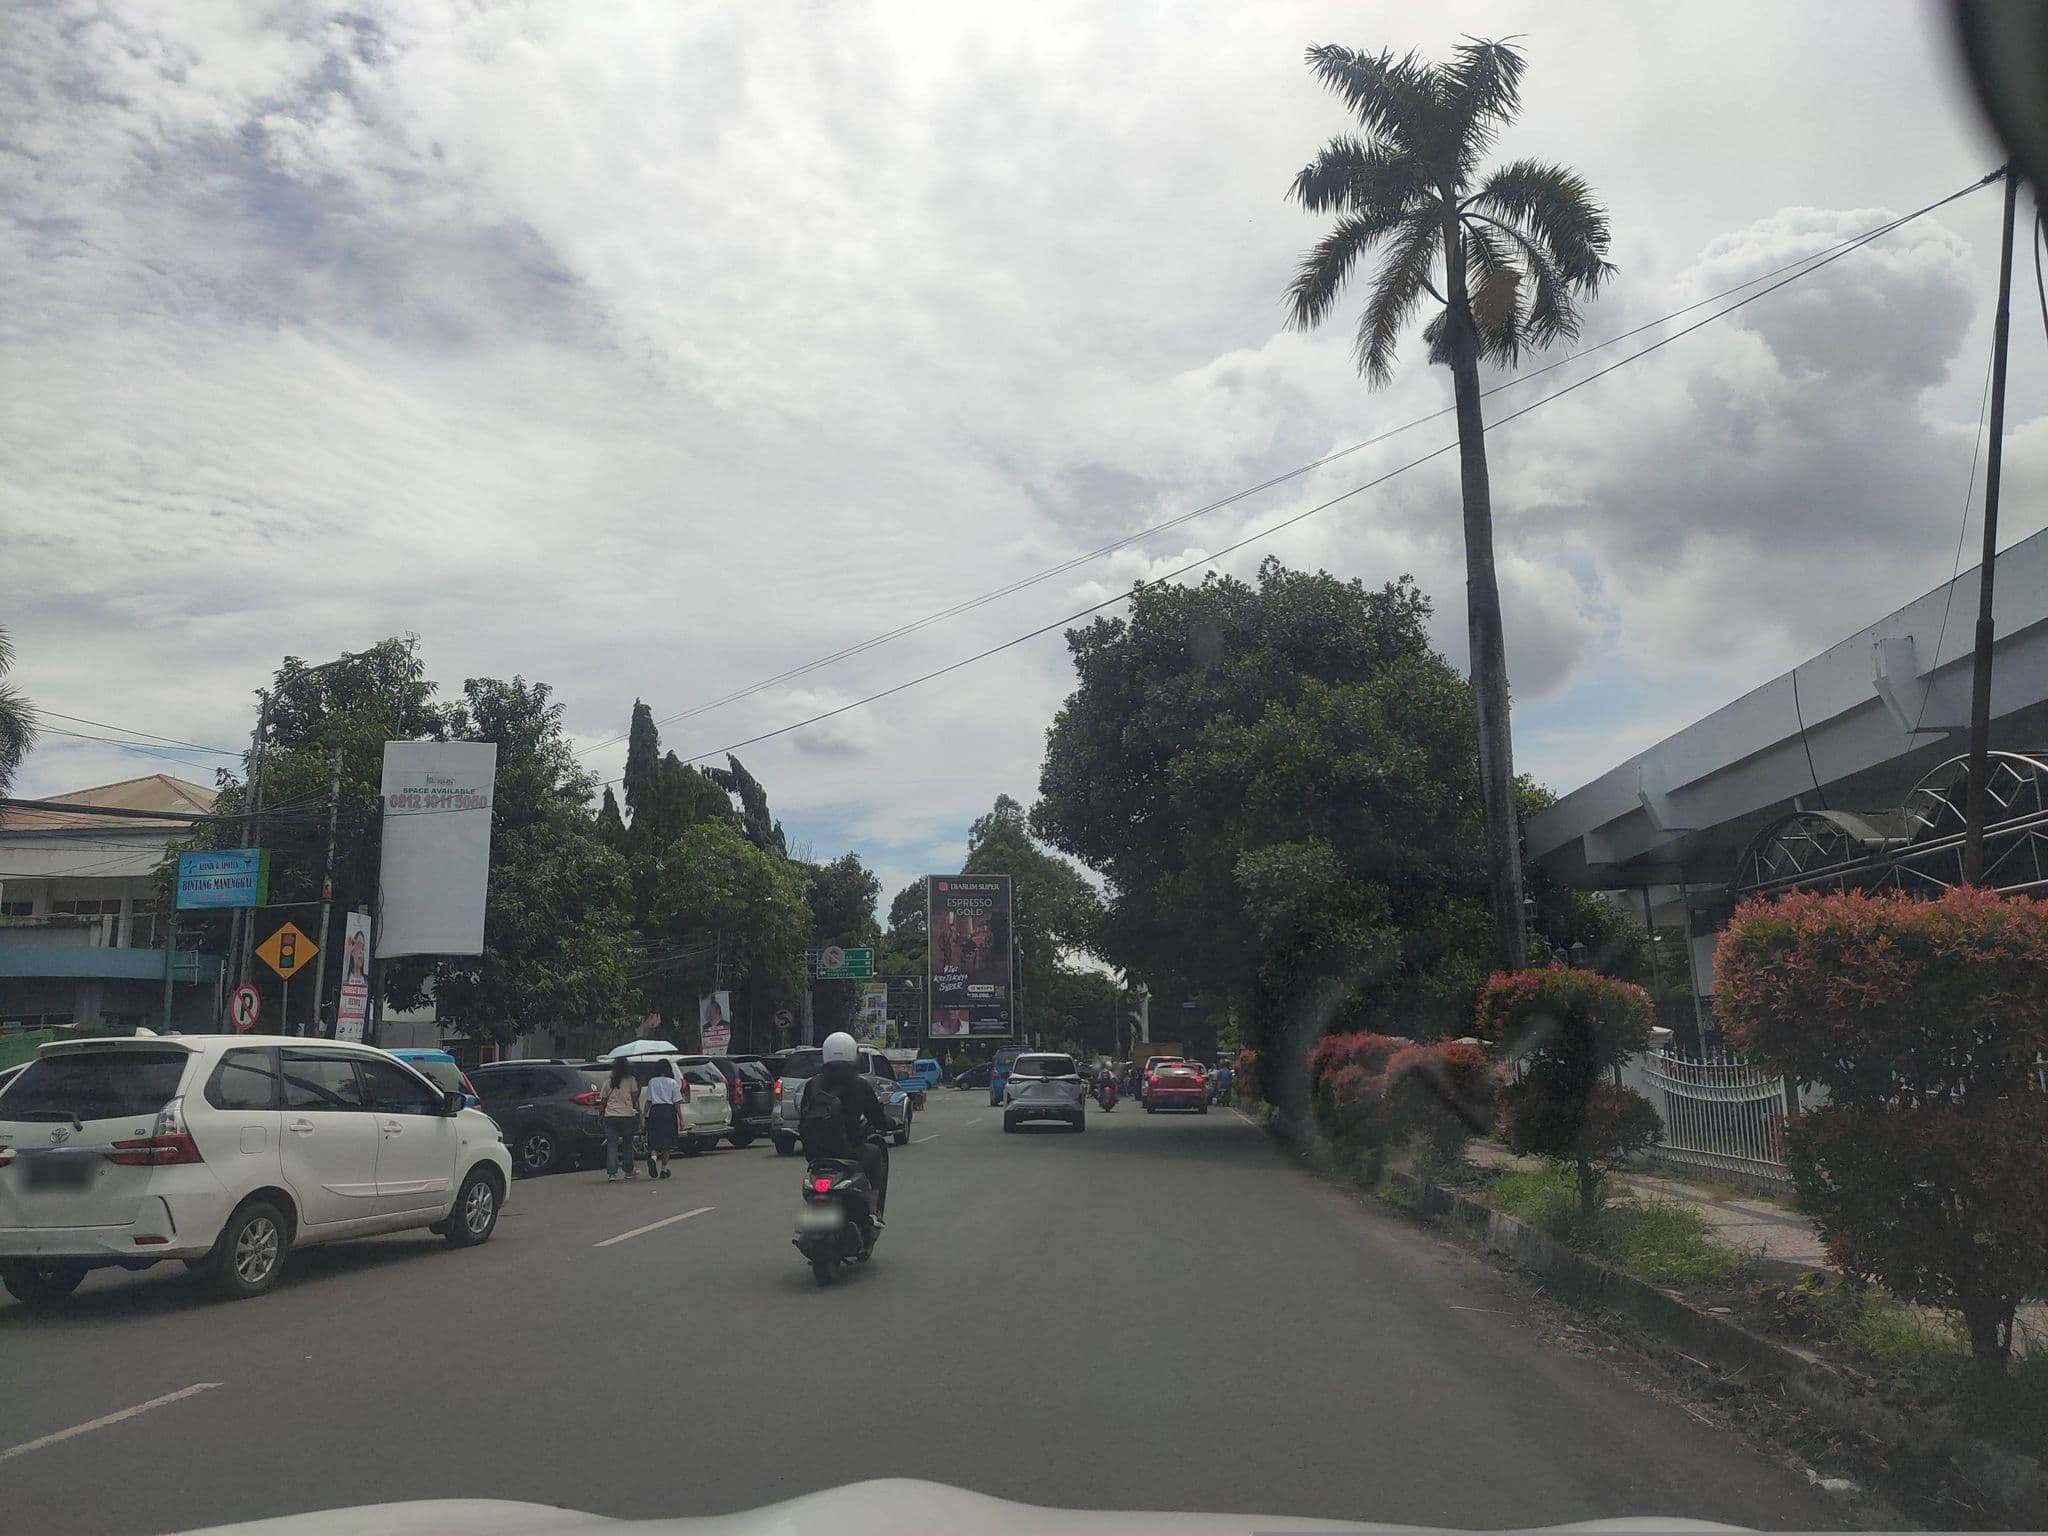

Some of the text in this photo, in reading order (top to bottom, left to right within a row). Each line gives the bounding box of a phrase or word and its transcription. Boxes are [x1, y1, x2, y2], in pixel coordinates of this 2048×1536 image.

[182, 879, 212, 891] BINTANG
[947, 898, 993, 907] ESPRESSO
[956, 908, 983, 916] GOLD
